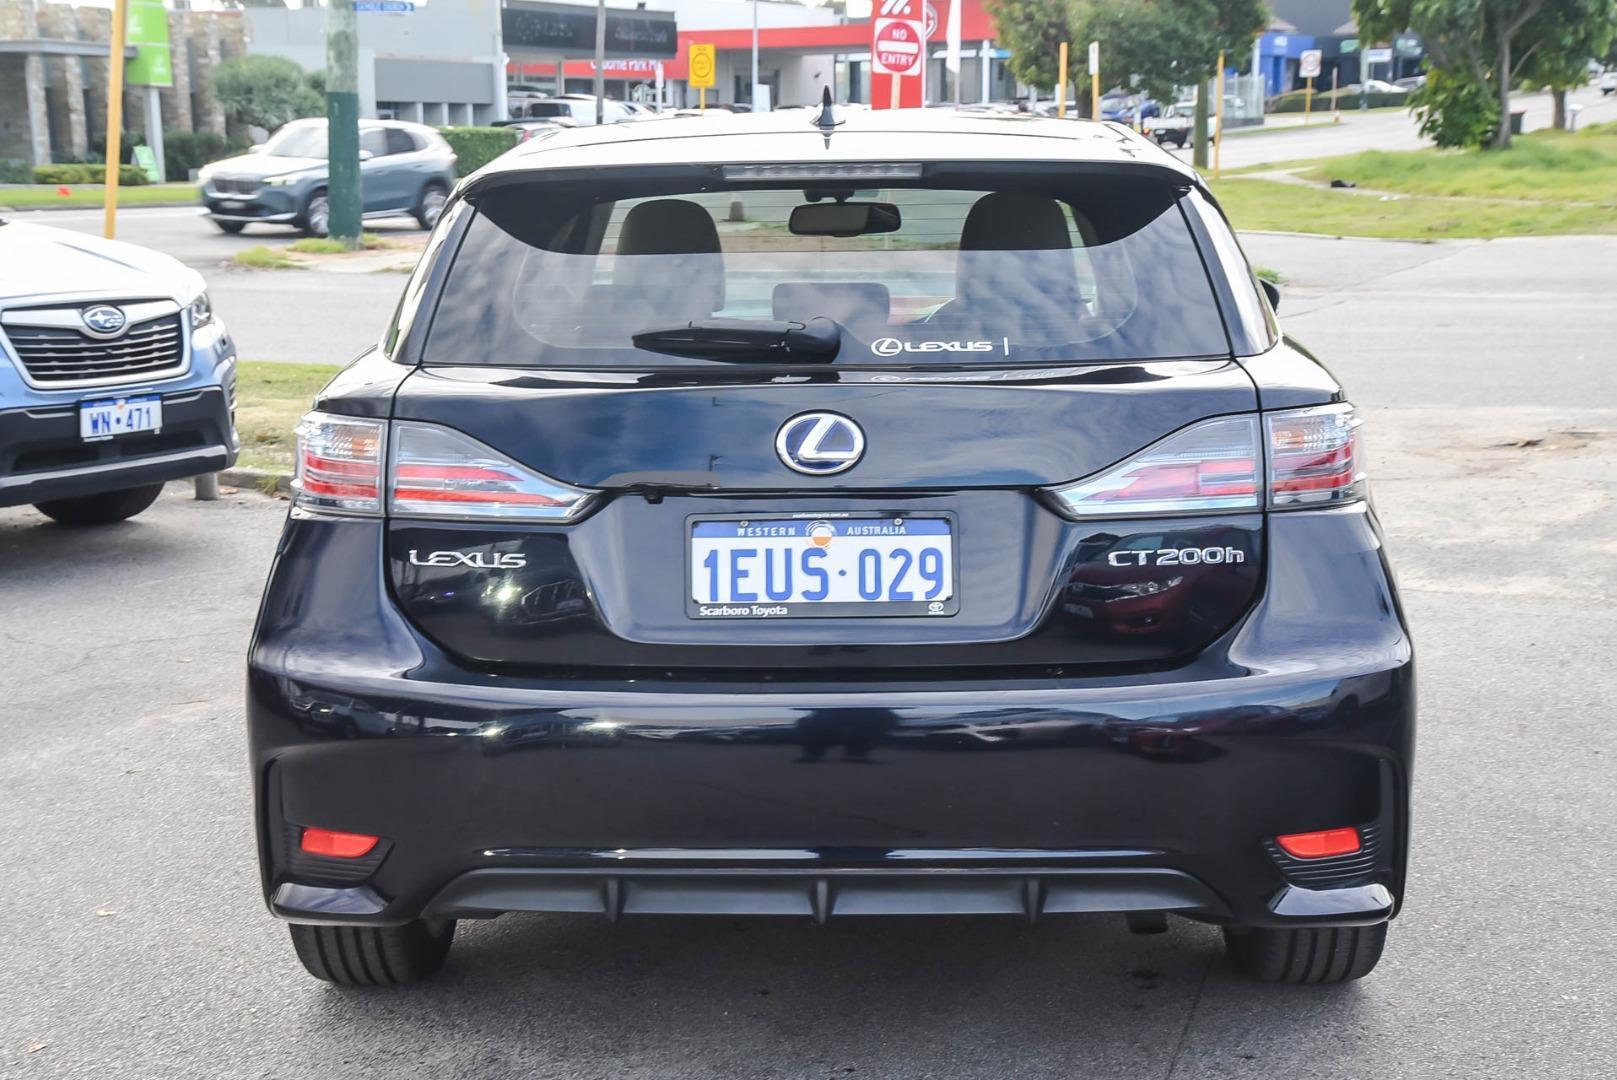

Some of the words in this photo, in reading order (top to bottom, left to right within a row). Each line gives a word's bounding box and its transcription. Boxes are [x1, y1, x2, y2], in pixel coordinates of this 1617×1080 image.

[891, 28, 908, 40] NO
[880, 52, 914, 66] ENTRY
[904, 341, 993, 352] LEXUS
[736, 527, 796, 536] WESTERN
[846, 526, 907, 535] AUSTRALIA
[409, 549, 527, 569] LEXUS
[1107, 546, 1245, 567] CT200h
[699, 605, 750, 616] Scarboro
[751, 605, 788, 617] Toyota
